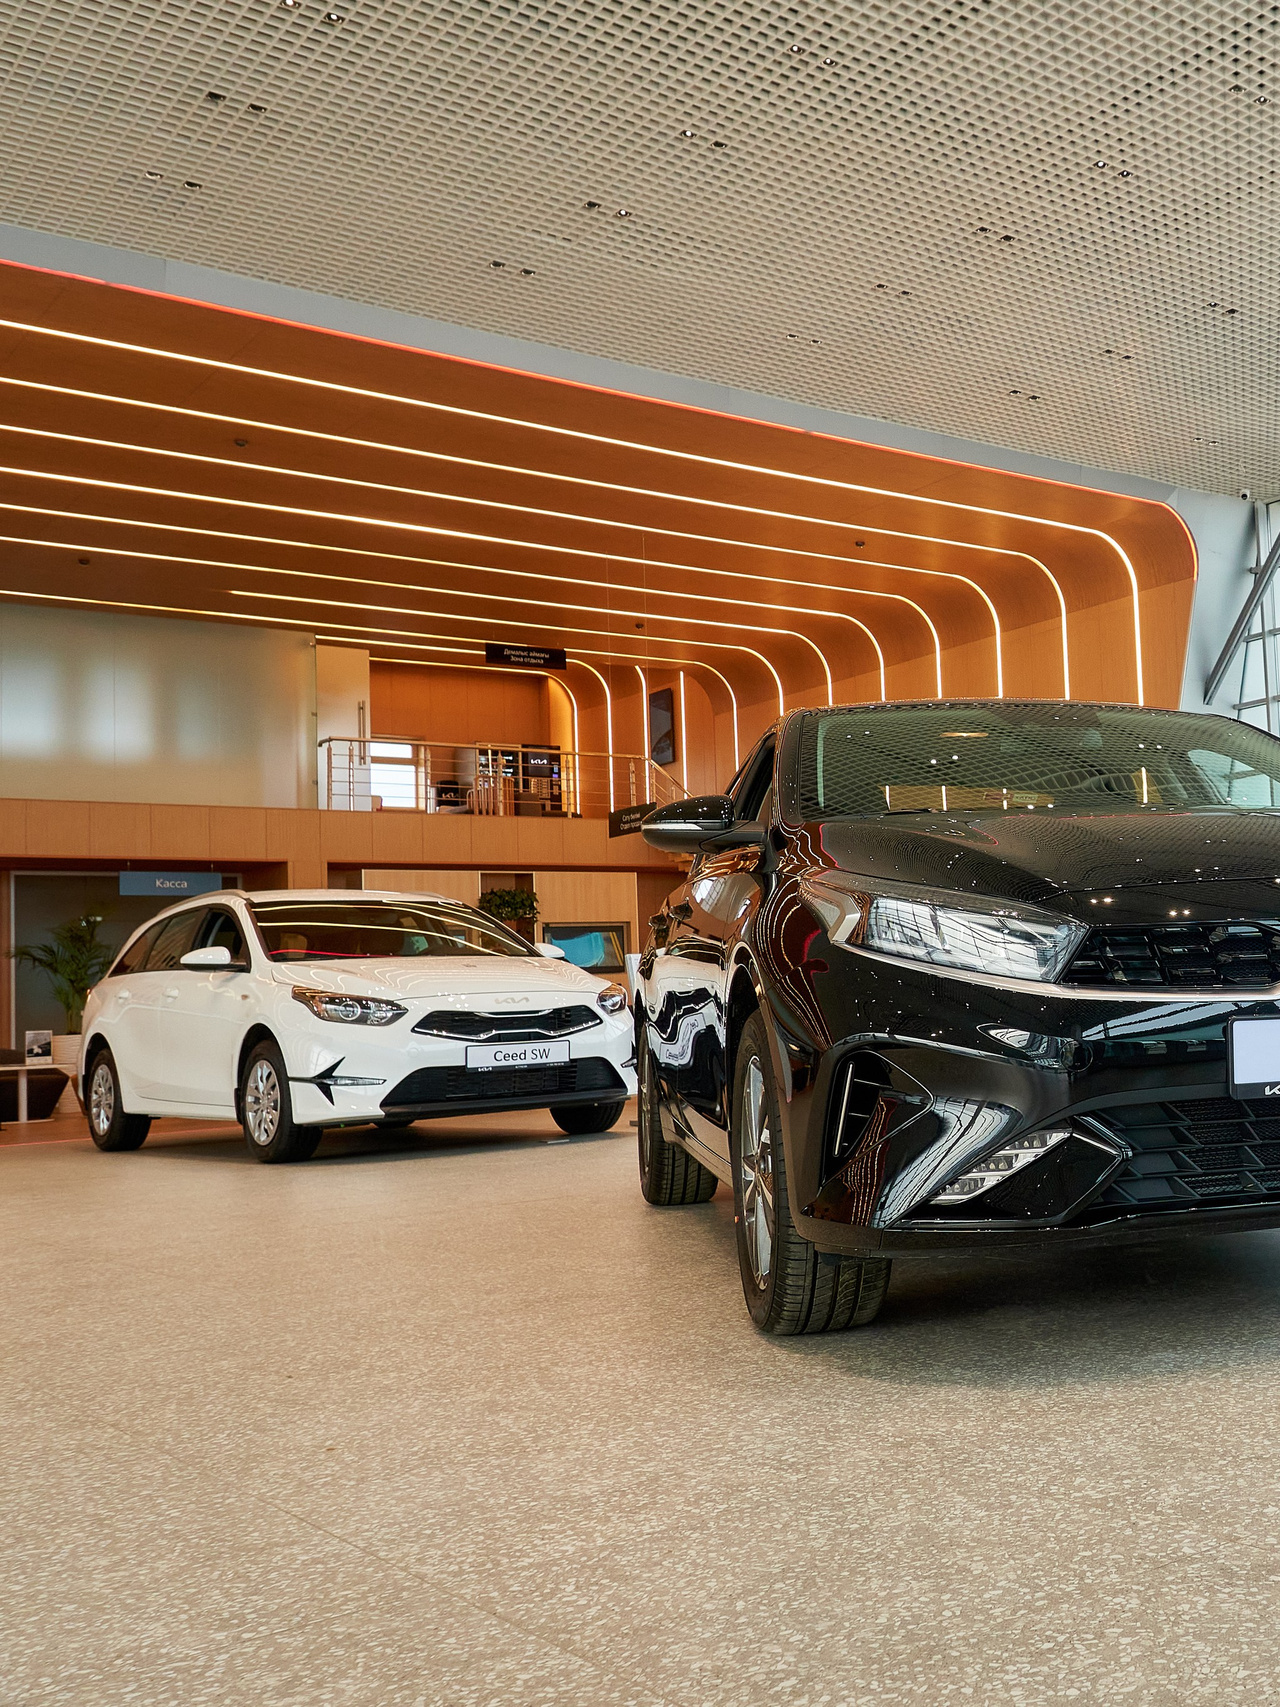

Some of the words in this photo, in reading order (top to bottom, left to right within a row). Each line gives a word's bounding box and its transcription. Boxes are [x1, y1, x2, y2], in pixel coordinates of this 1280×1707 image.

[155, 879, 188, 888] Касса
[494, 996, 530, 1005] KIA
[494, 1050, 527, 1062] Ceed
[531, 1048, 551, 1060] SW
